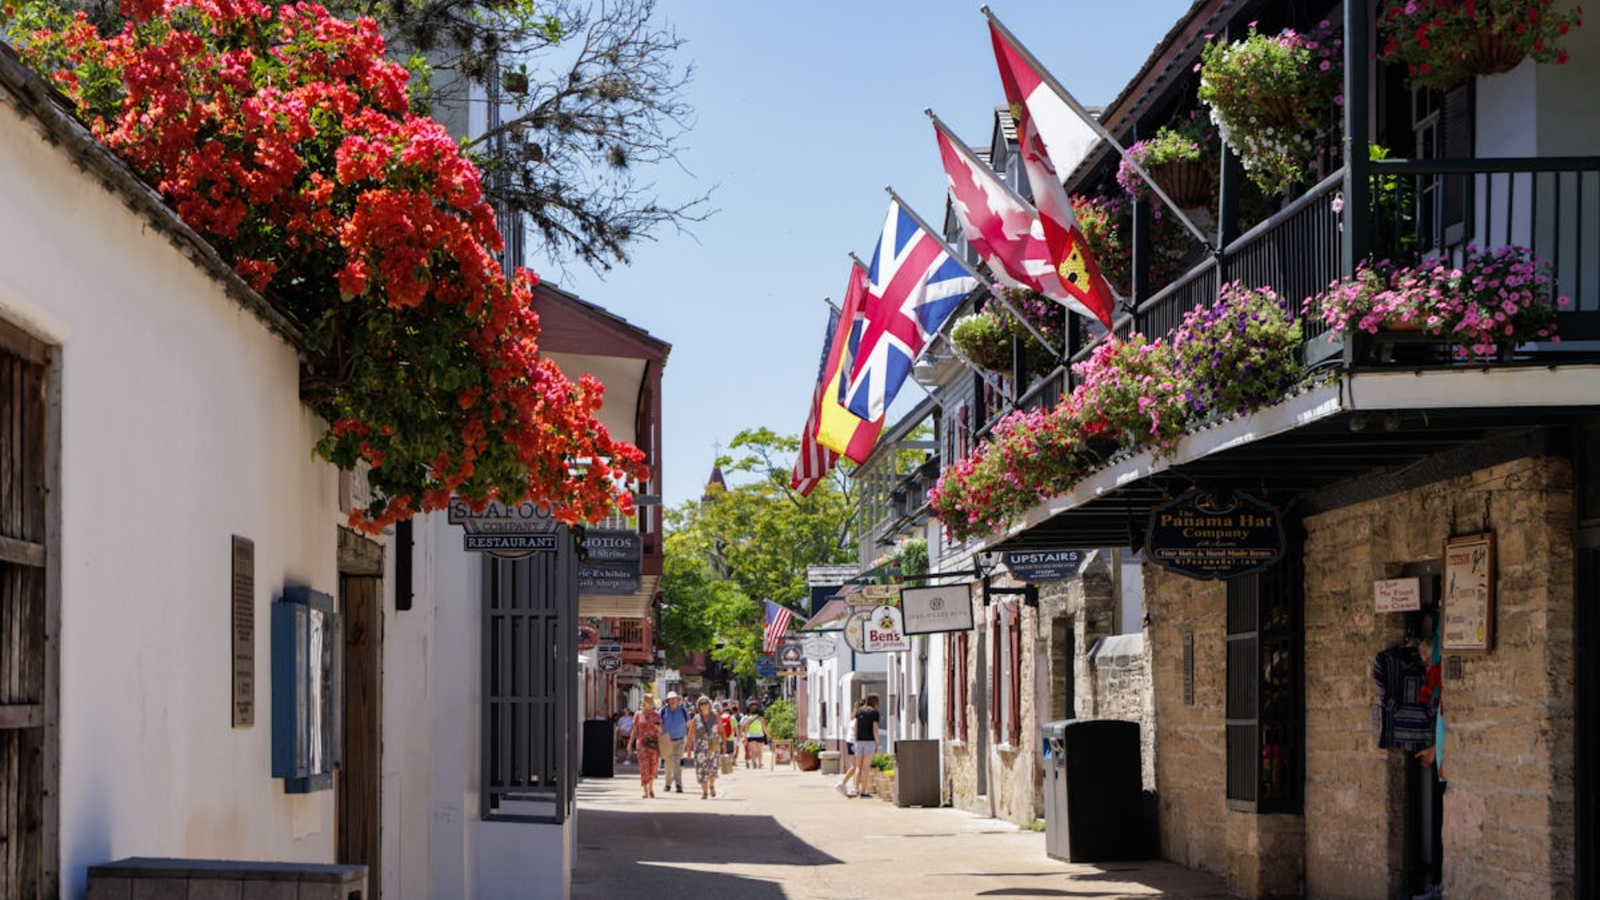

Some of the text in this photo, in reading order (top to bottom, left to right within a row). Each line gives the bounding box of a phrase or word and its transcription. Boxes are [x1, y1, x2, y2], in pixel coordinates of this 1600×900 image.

[1160, 514, 1273, 527] Panama Hat
[482, 522, 540, 531] COMPANY
[1182, 527, 1249, 540] Company
[468, 538, 554, 547] RESTAURANT
[581, 538, 631, 548] HOTIOS
[598, 550, 627, 558] Shrine
[1010, 552, 1078, 564] UPSTAIRS
